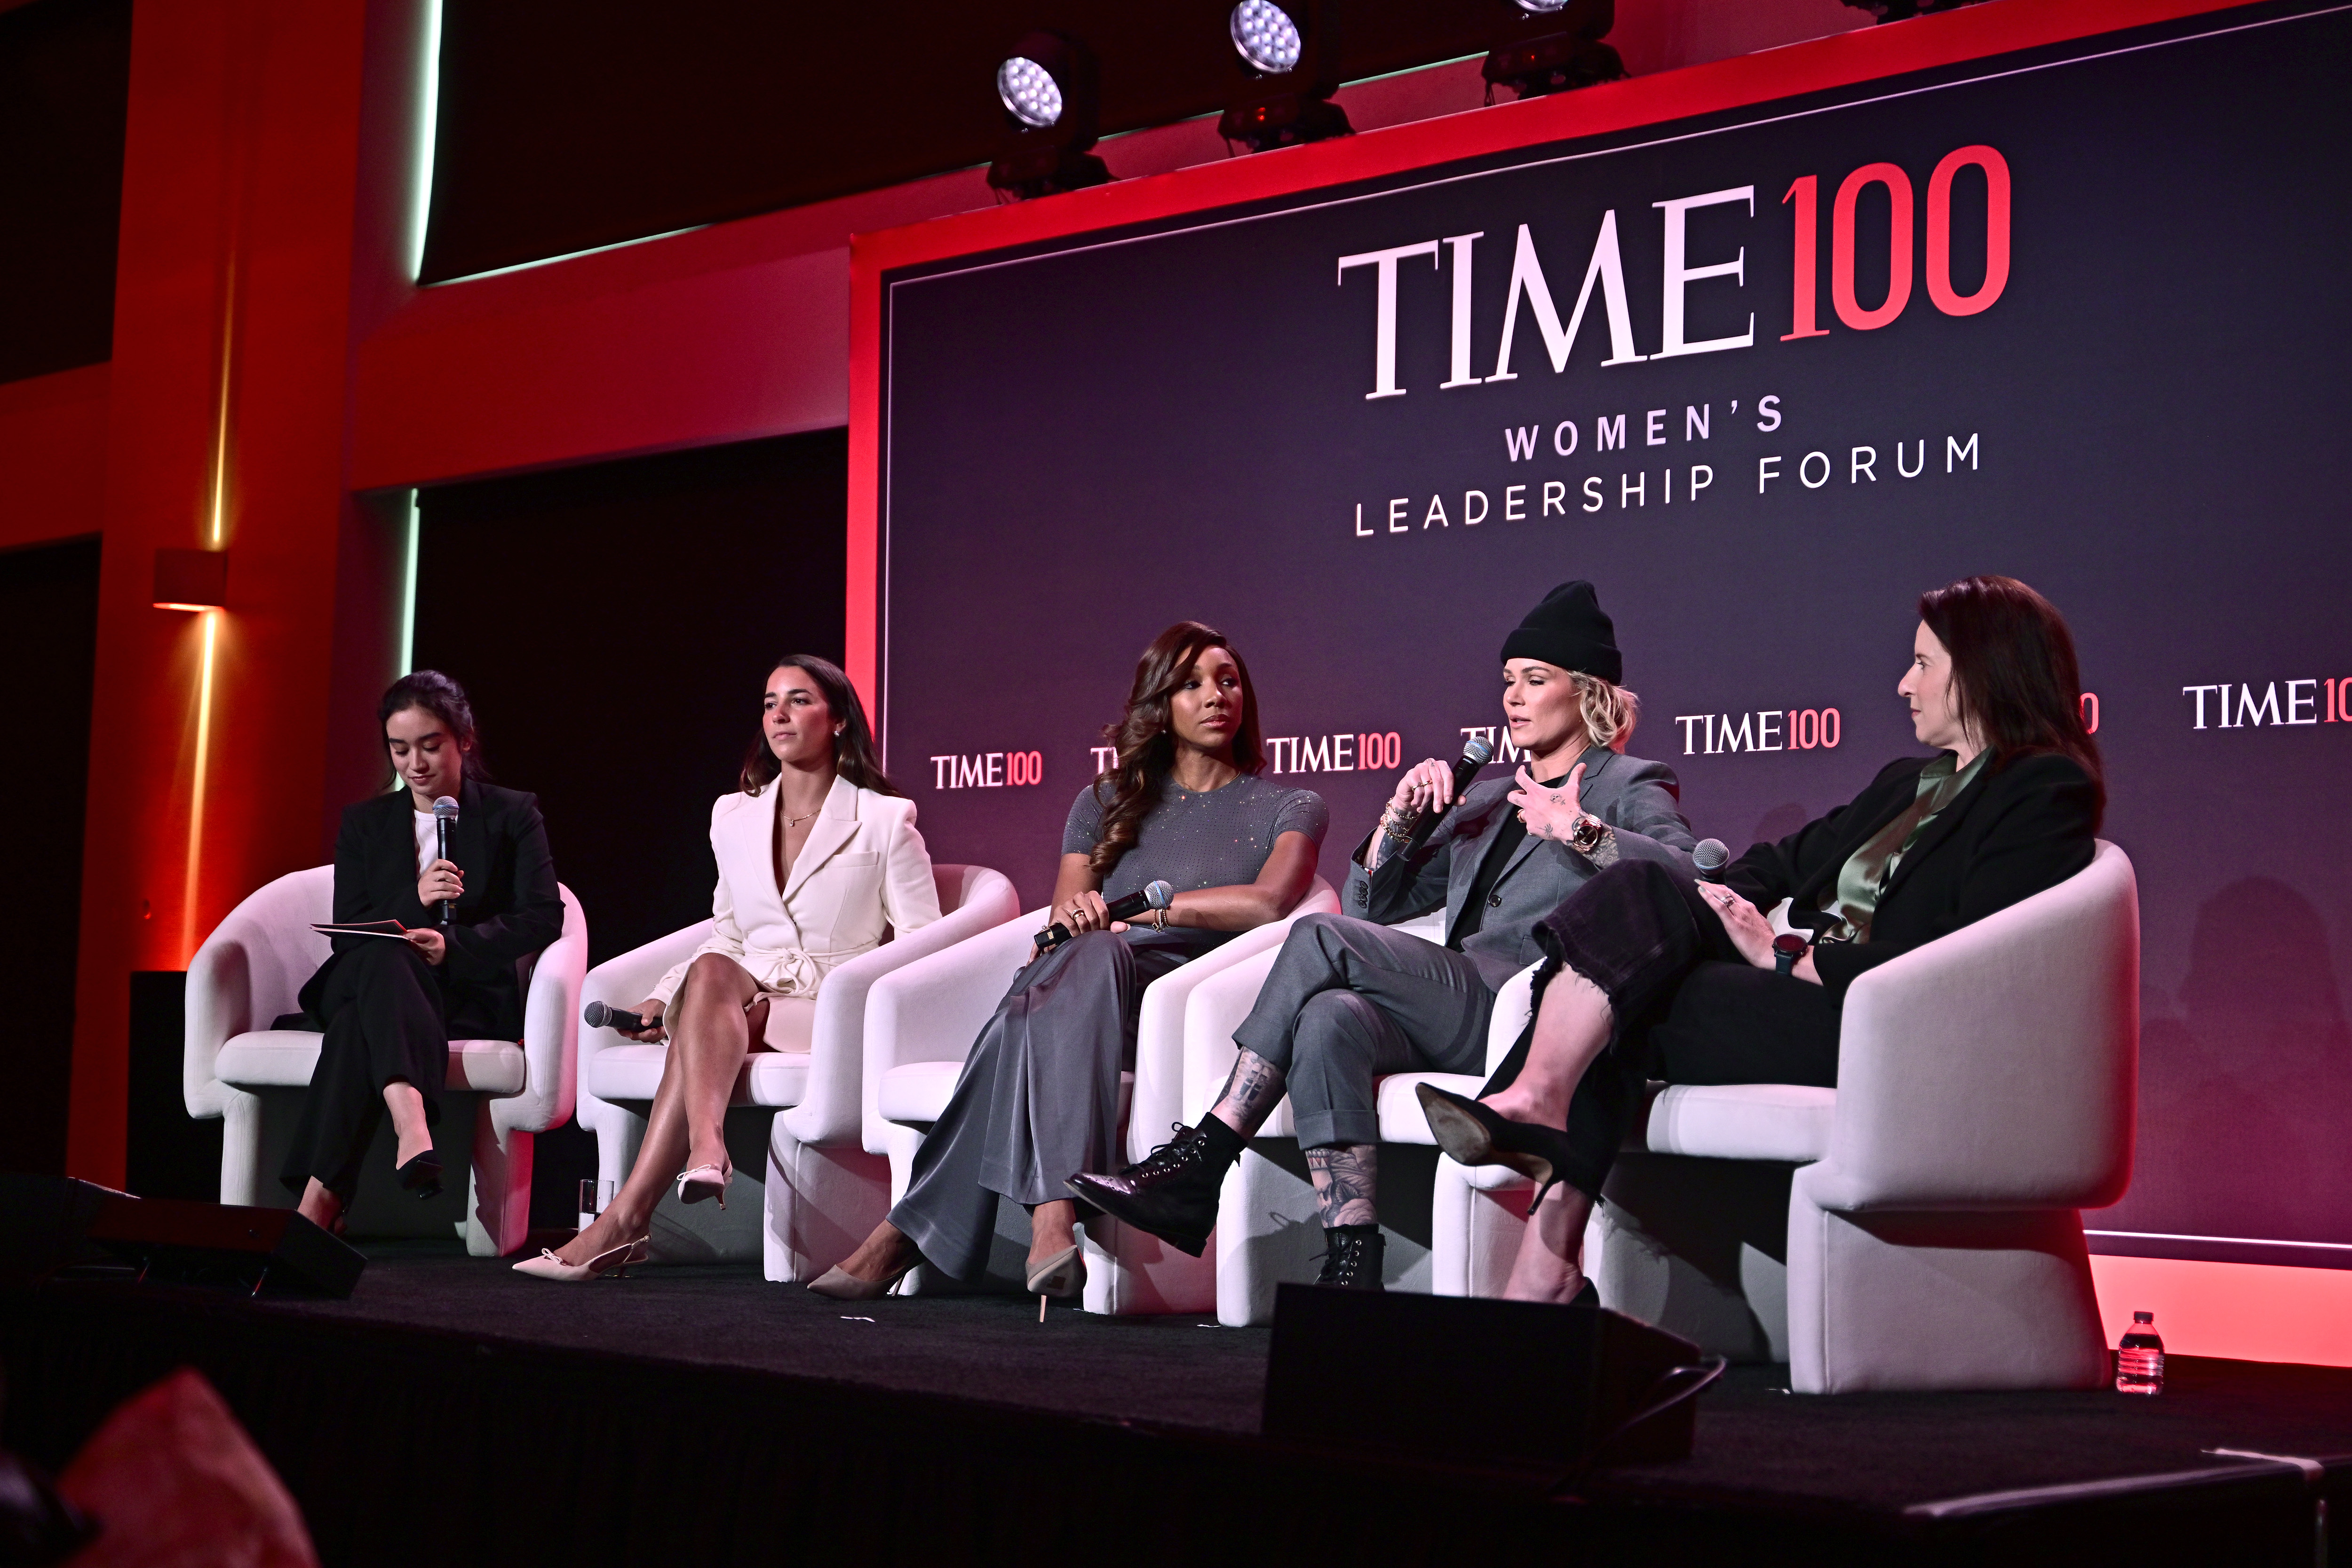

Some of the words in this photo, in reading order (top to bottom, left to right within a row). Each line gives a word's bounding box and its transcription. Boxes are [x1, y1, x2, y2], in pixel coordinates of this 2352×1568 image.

[1505, 395, 1782, 462] WOMEN'S
[1356, 465, 1714, 537] LEADERSHIP
[1759, 433, 1978, 494] FORUM
[2183, 677, 2352, 729] TIME10
